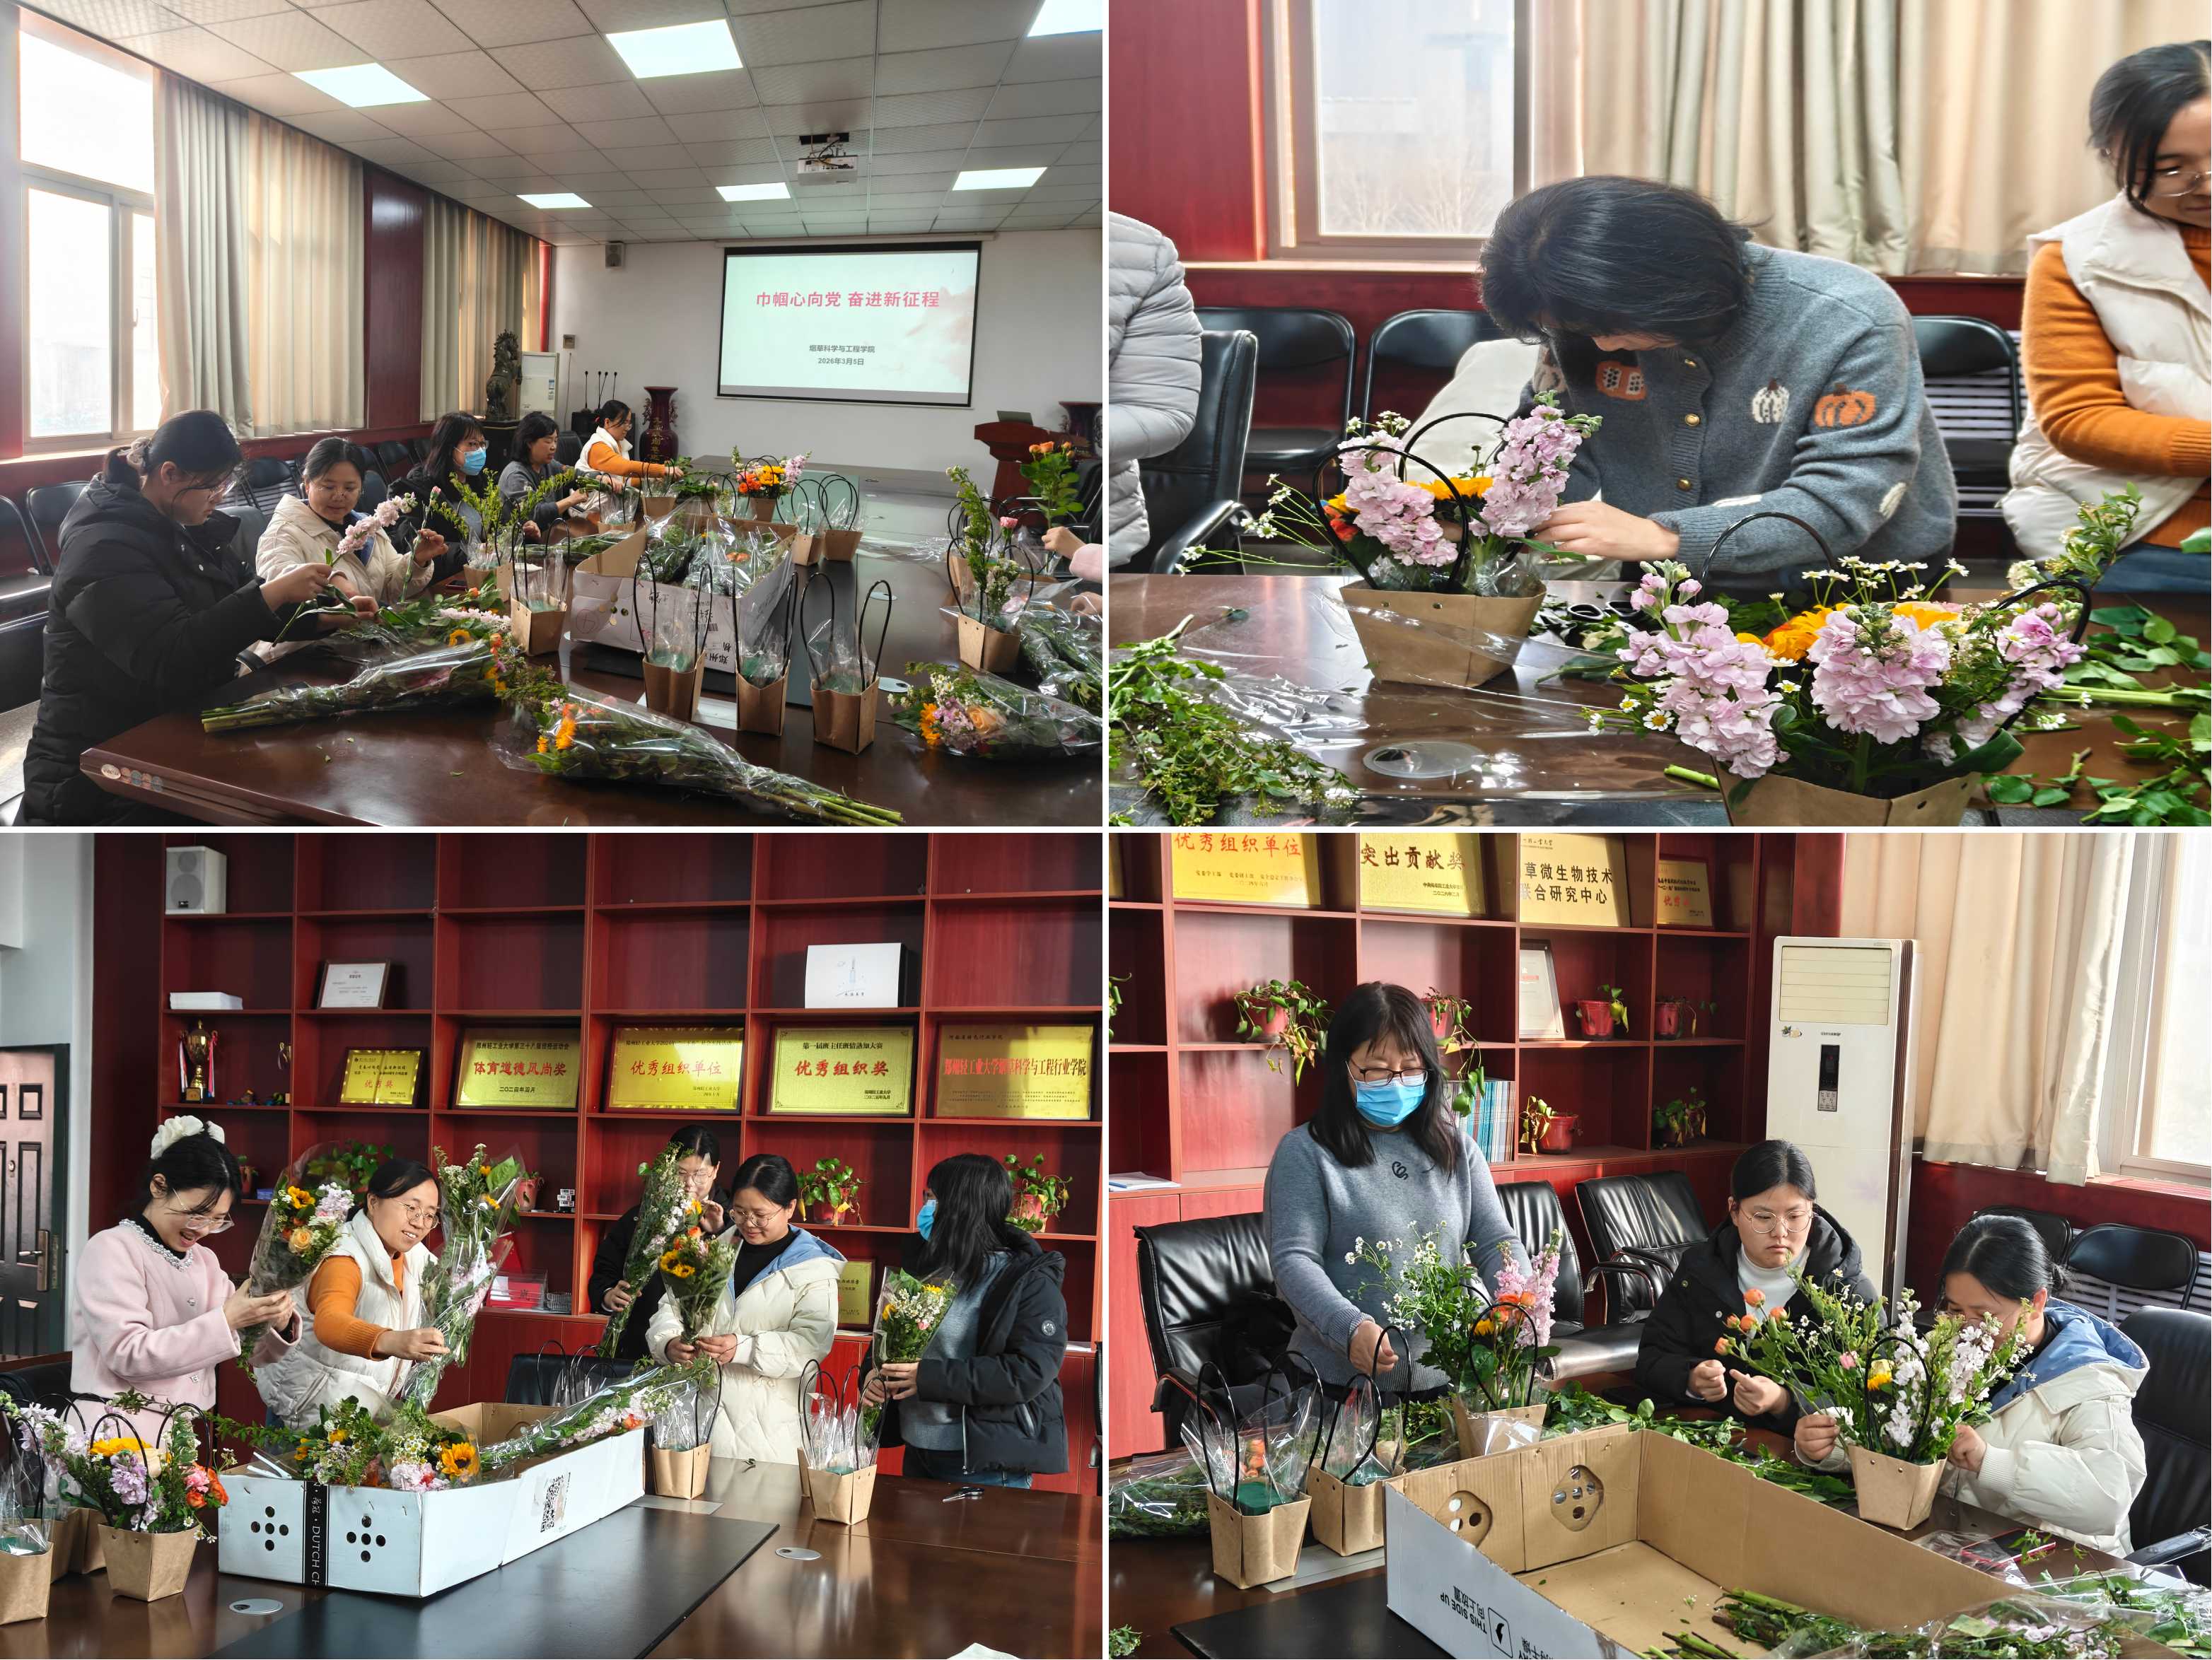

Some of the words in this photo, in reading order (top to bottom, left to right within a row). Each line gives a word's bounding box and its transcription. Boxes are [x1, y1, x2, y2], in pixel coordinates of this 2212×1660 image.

[756, 291, 842, 308] 巾帼心向党
[847, 291, 940, 308] 奋进新征程
[809, 344, 875, 353] 烟草科学与工程学院
[817, 357, 865, 366] 2026年3月5日
[1175, 833, 1302, 858] 优秀组织单位
[1361, 843, 1466, 871] 突出贡献奖
[1525, 862, 1613, 884] 草微生物技术
[474, 1062, 566, 1076] 体育道德风尚奖
[630, 1060, 722, 1076] 优秀组织单位
[795, 1060, 889, 1077] 优秀组织奖
[312, 1526, 320, 1568] DUTCH
[1440, 1592, 1450, 1606] UP
[1452, 1599, 1468, 1620] SIDE
[1469, 1614, 1487, 1635] THIS
